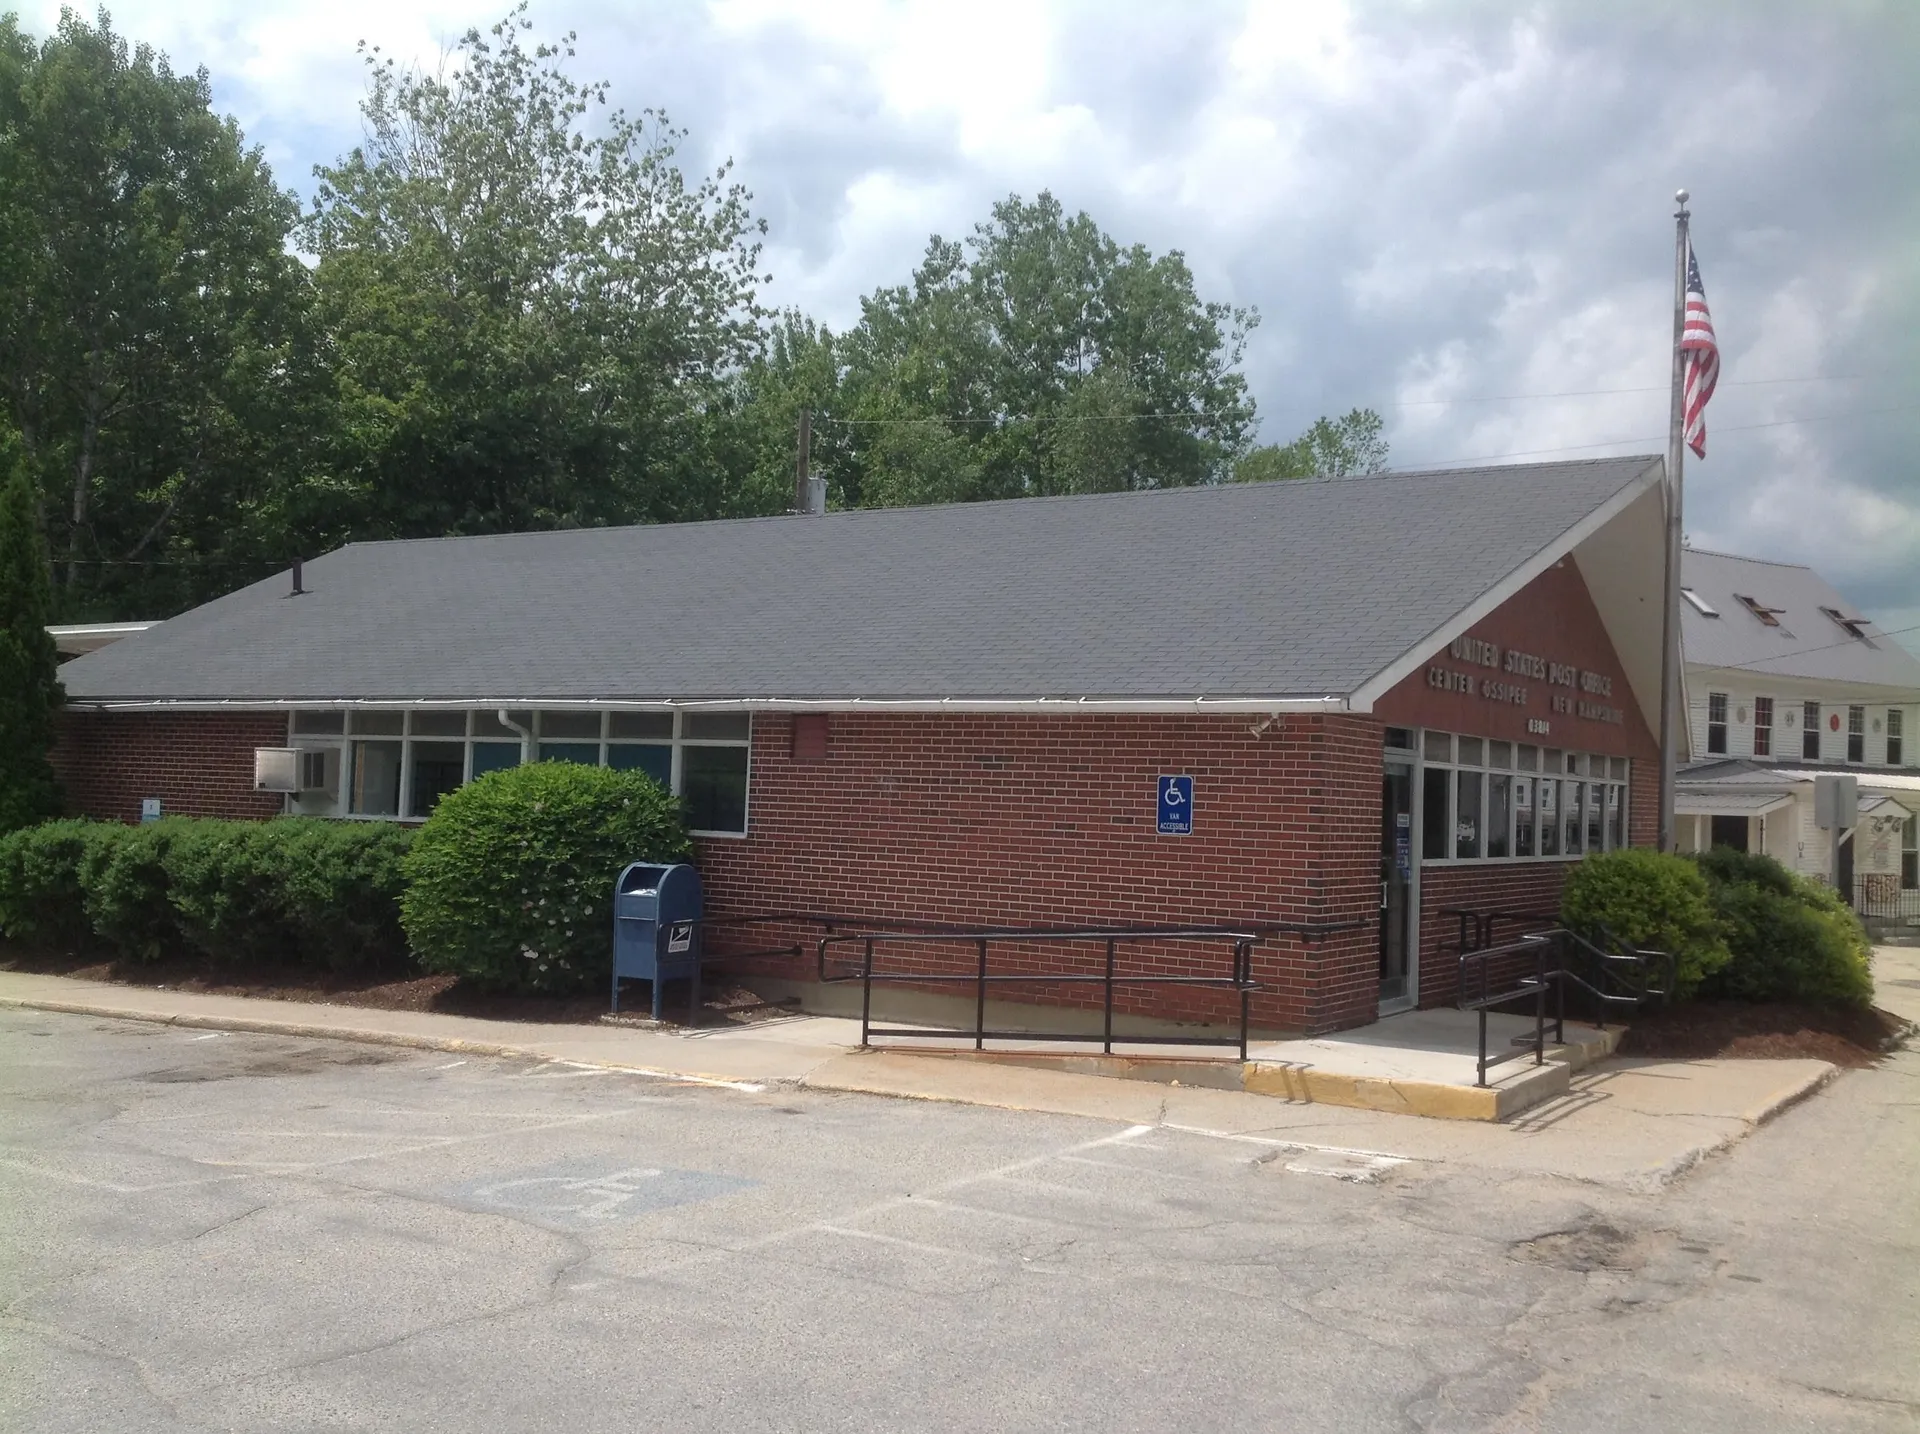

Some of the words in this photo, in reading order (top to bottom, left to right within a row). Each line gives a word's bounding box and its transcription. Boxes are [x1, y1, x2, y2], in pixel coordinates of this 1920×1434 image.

[1429, 667, 1474, 694] CENTER
[1482, 680, 1527, 705] OSSIPEE
[1552, 696, 1572, 714] NEW
[1450, 637, 1498, 667] UNITED
[1505, 649, 1546, 680] STATES
[1548, 663, 1577, 687] POST
[1580, 670, 1612, 697] OFFICE
[1160, 822, 1189, 830] ACCESSIBLE
